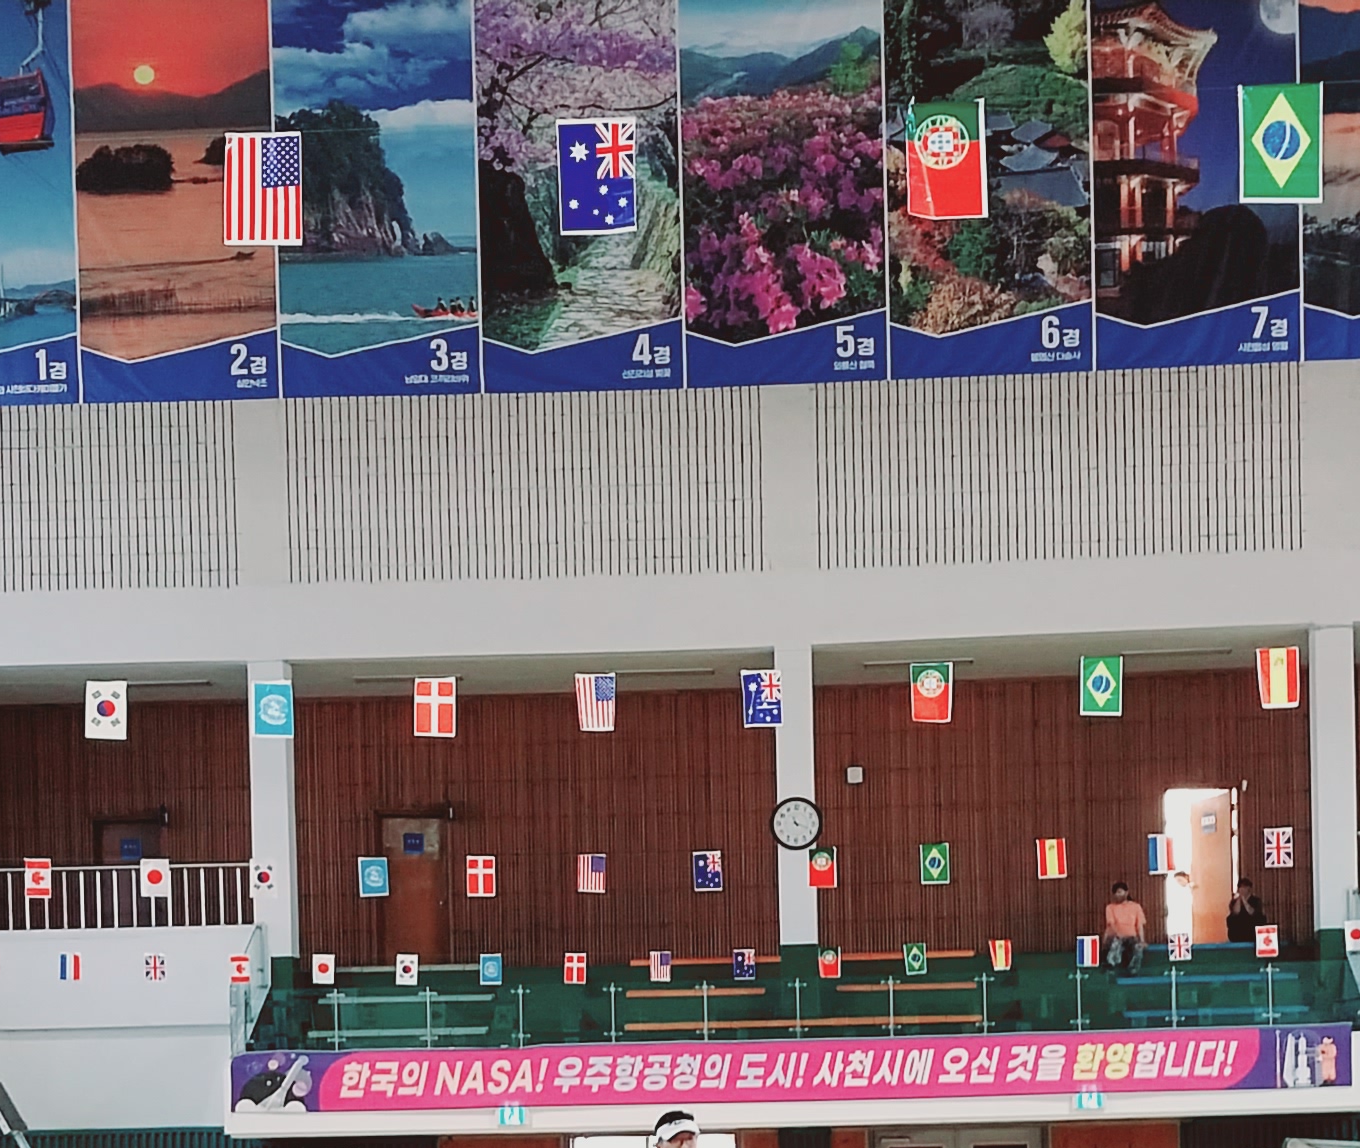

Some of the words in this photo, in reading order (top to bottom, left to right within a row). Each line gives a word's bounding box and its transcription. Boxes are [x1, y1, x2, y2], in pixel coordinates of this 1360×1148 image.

[1042, 315, 1080, 348] 6경
[1251, 306, 1288, 338] 7경
[430, 338, 468, 371] 3경
[632, 333, 671, 365] 4경
[836, 325, 875, 357] 5경
[35, 349, 67, 380] 1경
[230, 343, 267, 375] 2경
[340, 1060, 429, 1098] 한국의
[434, 1057, 548, 1096] NASA!
[552, 1053, 732, 1094] 우주항공청의
[735, 1050, 809, 1089] 도시!
[812, 1045, 933, 1088] 사천시에
[937, 1043, 1000, 1084] 오신
[1005, 1041, 1066, 1083] 것을
[1072, 1039, 1239, 1081] 환영합니다!
